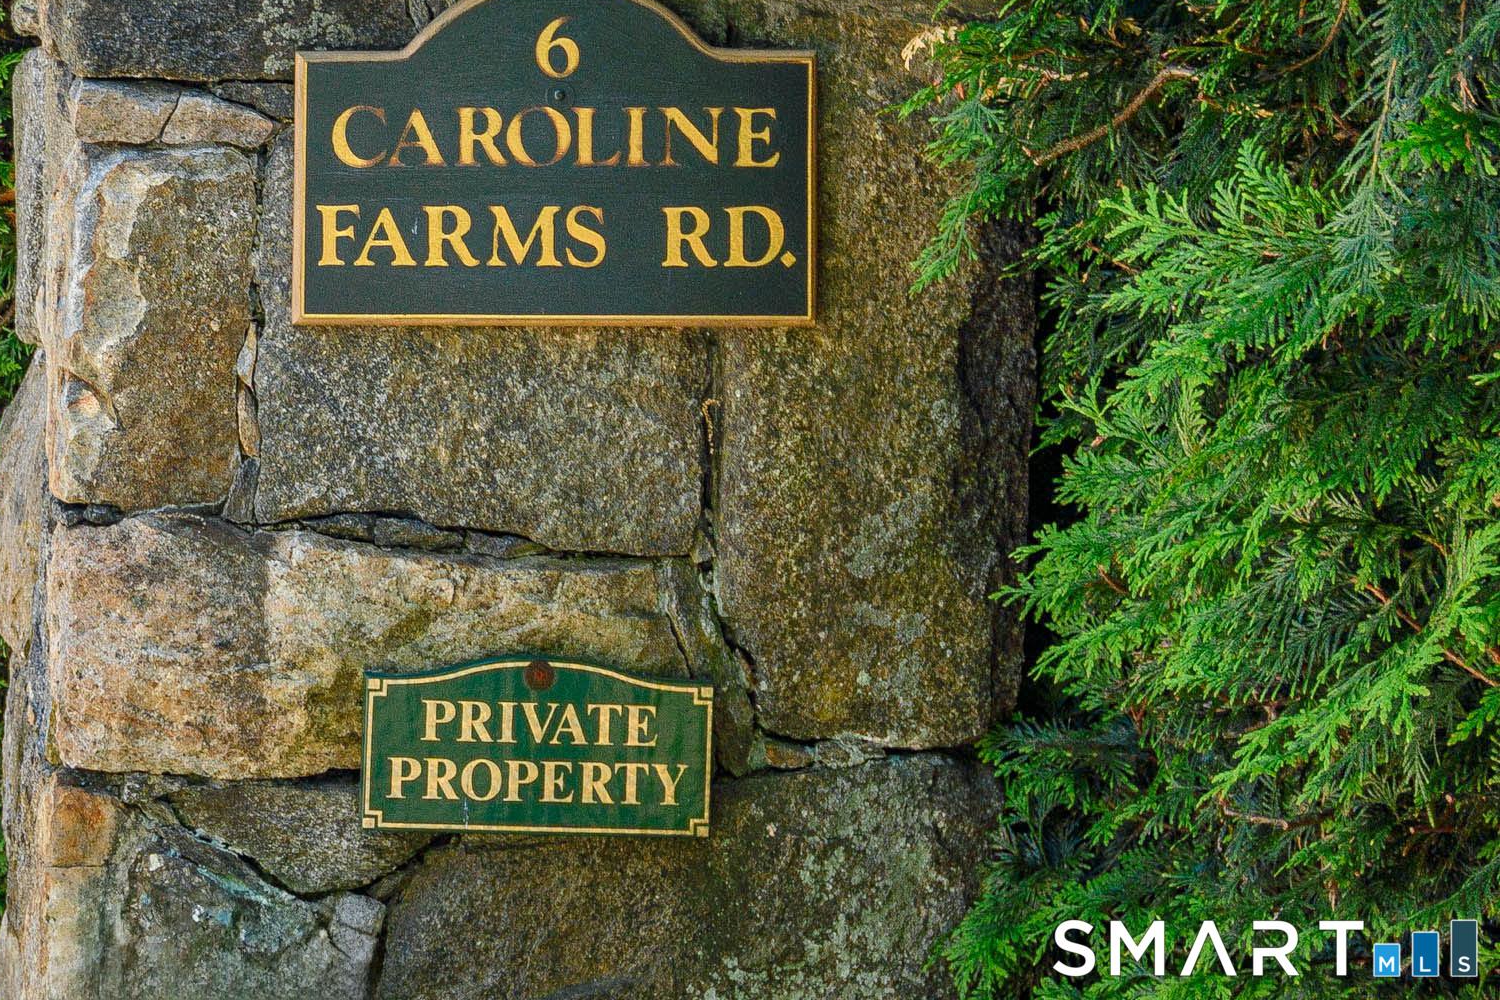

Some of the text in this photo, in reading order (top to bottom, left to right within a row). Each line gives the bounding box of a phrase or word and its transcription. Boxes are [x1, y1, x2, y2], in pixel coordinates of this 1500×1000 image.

[534, 16, 581, 79] 6
[330, 104, 782, 168] CAROLINE
[315, 203, 797, 269] FARMS RD.
[419, 699, 659, 748] PRIVATE
[385, 756, 690, 806] PROPERTY
